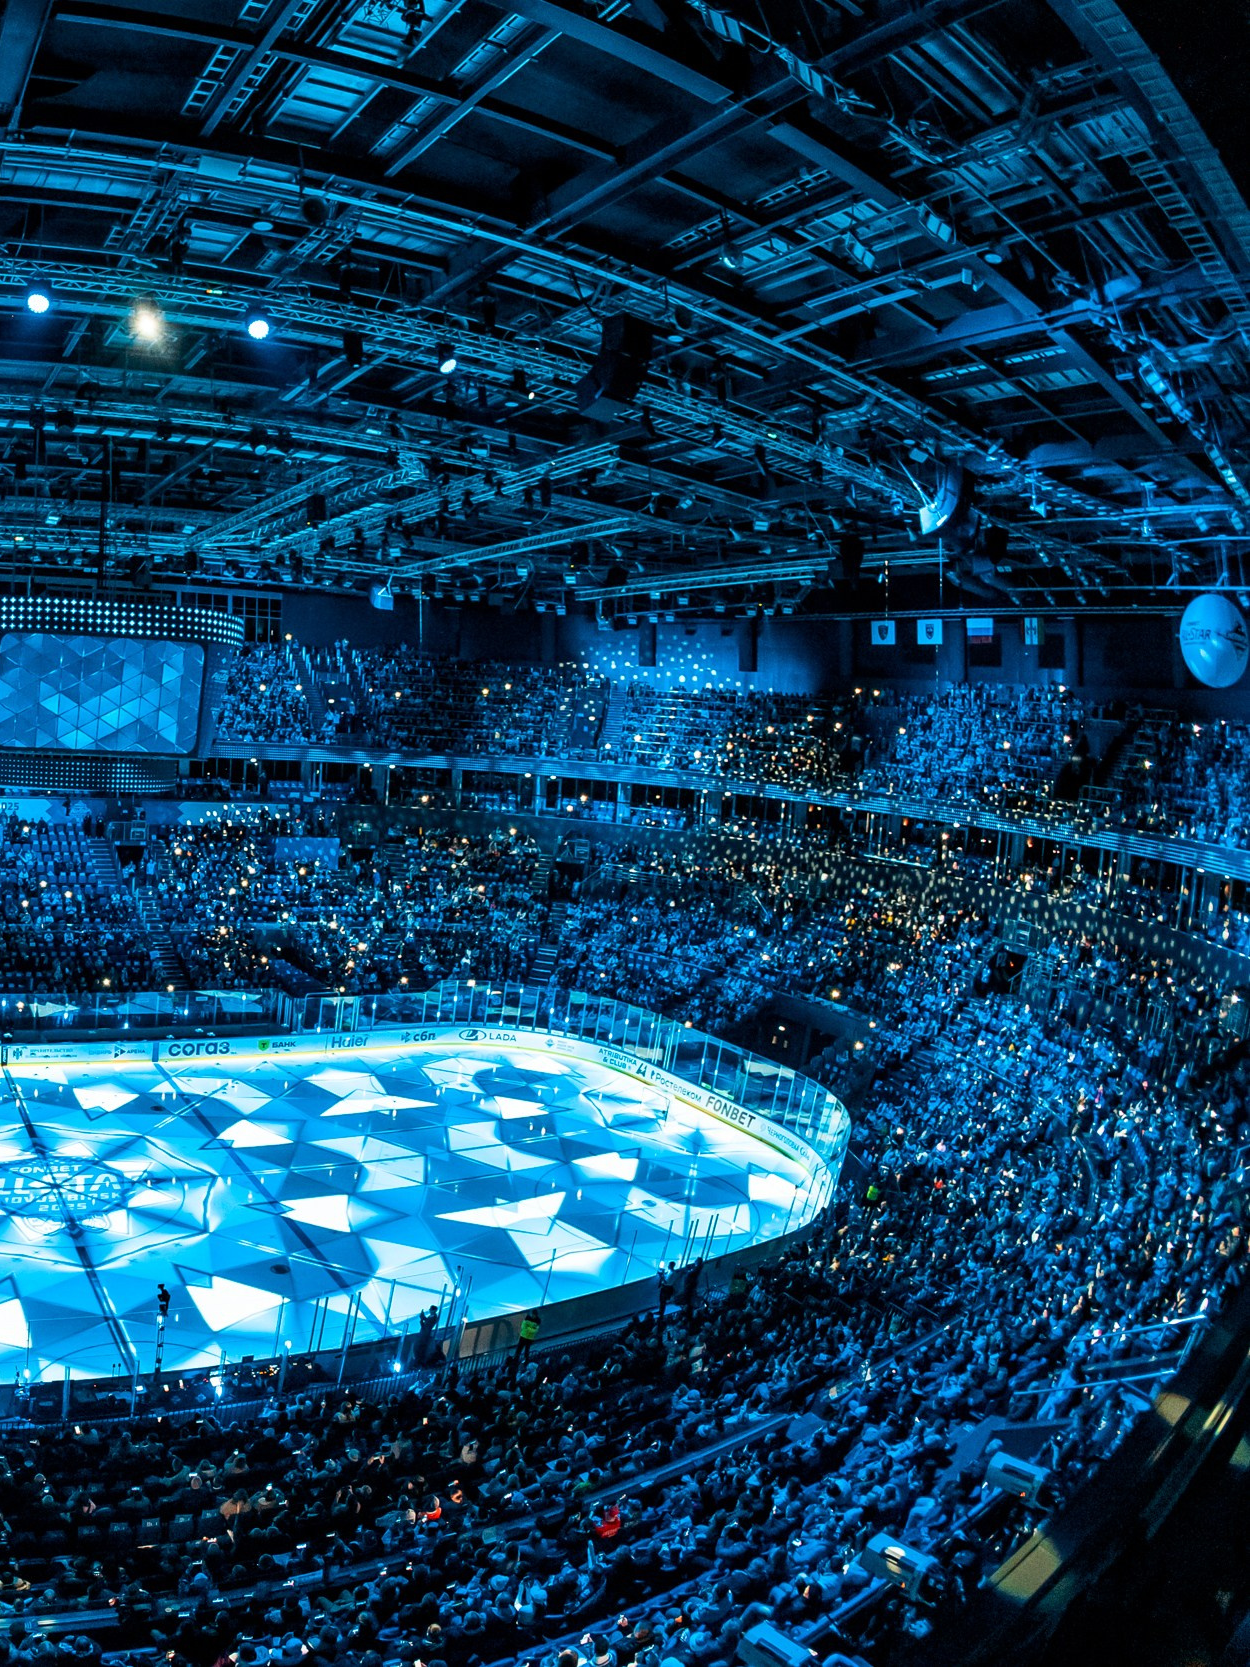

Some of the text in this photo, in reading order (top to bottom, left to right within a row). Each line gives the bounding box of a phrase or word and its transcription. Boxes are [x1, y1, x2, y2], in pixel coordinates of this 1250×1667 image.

[331, 1034, 369, 1048] Haier
[488, 1032, 517, 1042] LADA
[272, 1040, 297, 1049] БАНК
[599, 1048, 638, 1066] ATRIBUTIKA
[609, 1058, 627, 1070] CLUB
[705, 1096, 756, 1128] FONBET
